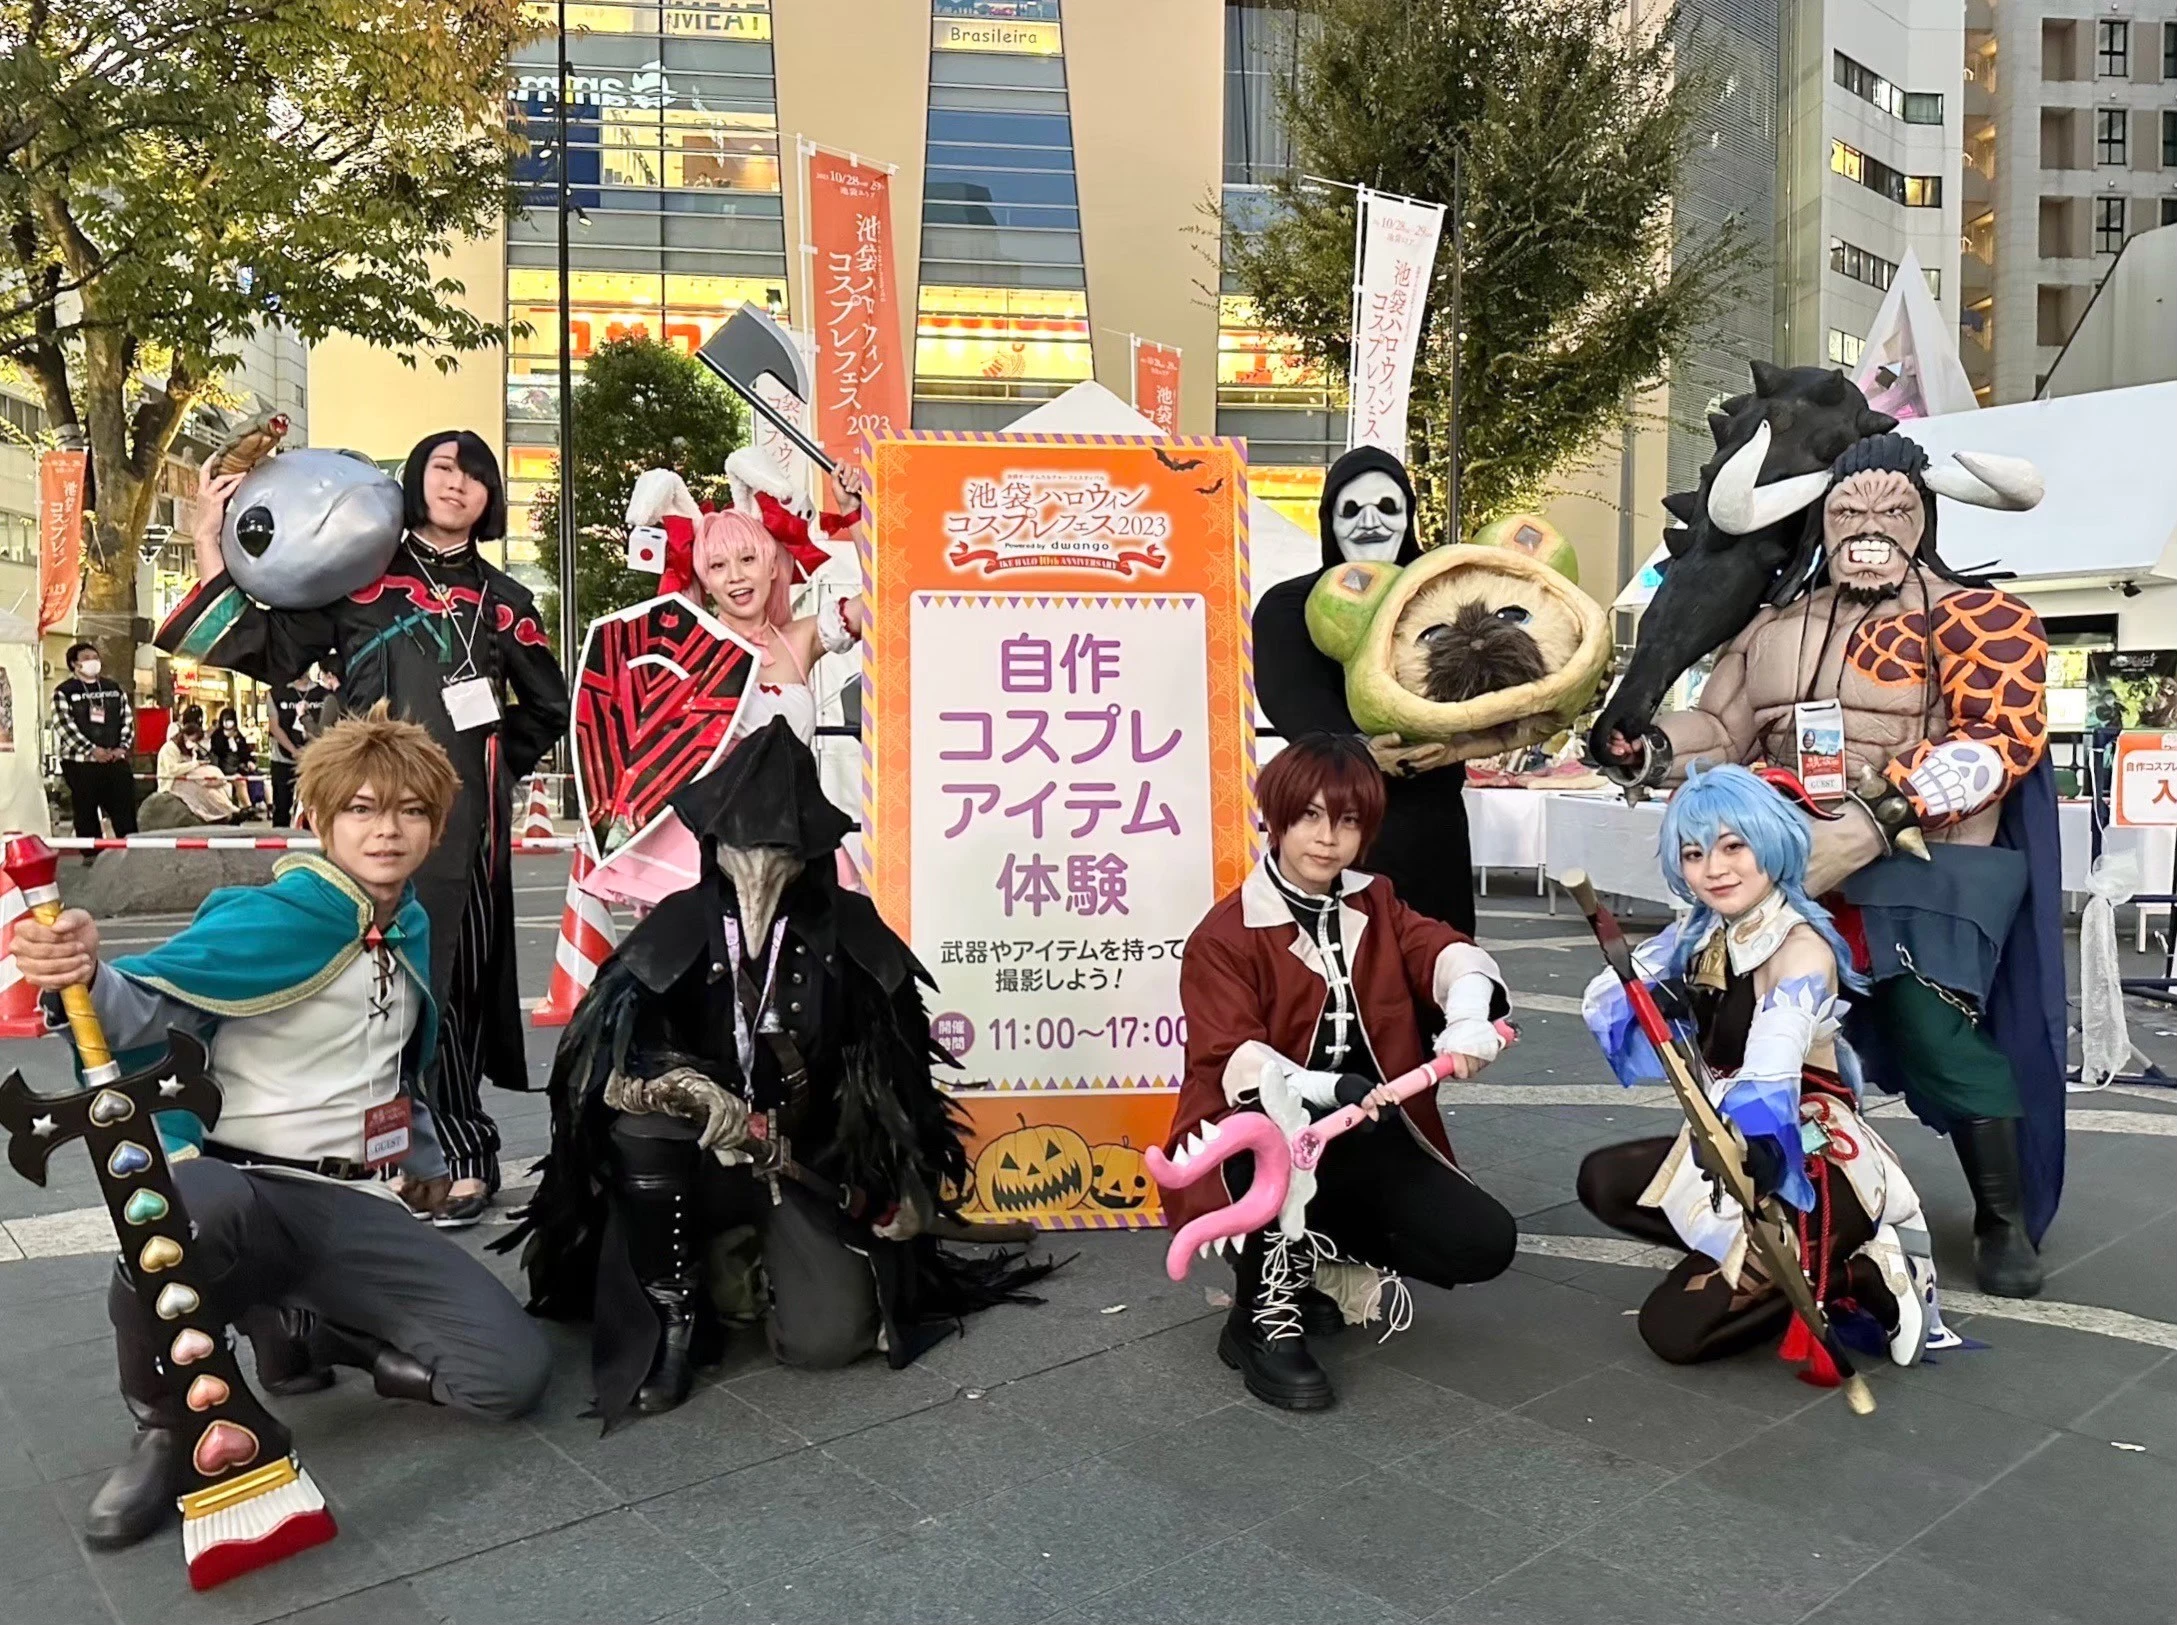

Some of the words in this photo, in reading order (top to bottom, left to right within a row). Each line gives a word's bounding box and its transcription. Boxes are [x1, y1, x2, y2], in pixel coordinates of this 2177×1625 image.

[672, 1, 765, 31] MEAT
[951, 27, 1037, 43] Brasileira
[825, 251, 863, 411] コスプレフェス
[1379, 259, 1412, 415] 池袋ハロウィン
[968, 482, 1145, 513] 池袋ハロウィン
[1037, 542, 1045, 550] by
[1051, 541, 1109, 551] dwango
[1061, 556, 1118, 570] ANNIVERSARY
[1001, 632, 1122, 694] 自作
[939, 703, 1183, 764] コスプレ
[2126, 761, 2177, 772] 自作コスプレ
[1811, 779, 1835, 789] GUEST
[2152, 779, 2177, 804] 入
[941, 780, 1182, 839] アイテム
[995, 852, 1130, 917] 体験
[940, 938, 1184, 964] 武器やアイテムを持って
[996, 967, 1123, 993] 撮影しよう!
[938, 1020, 965, 1035] 開催
